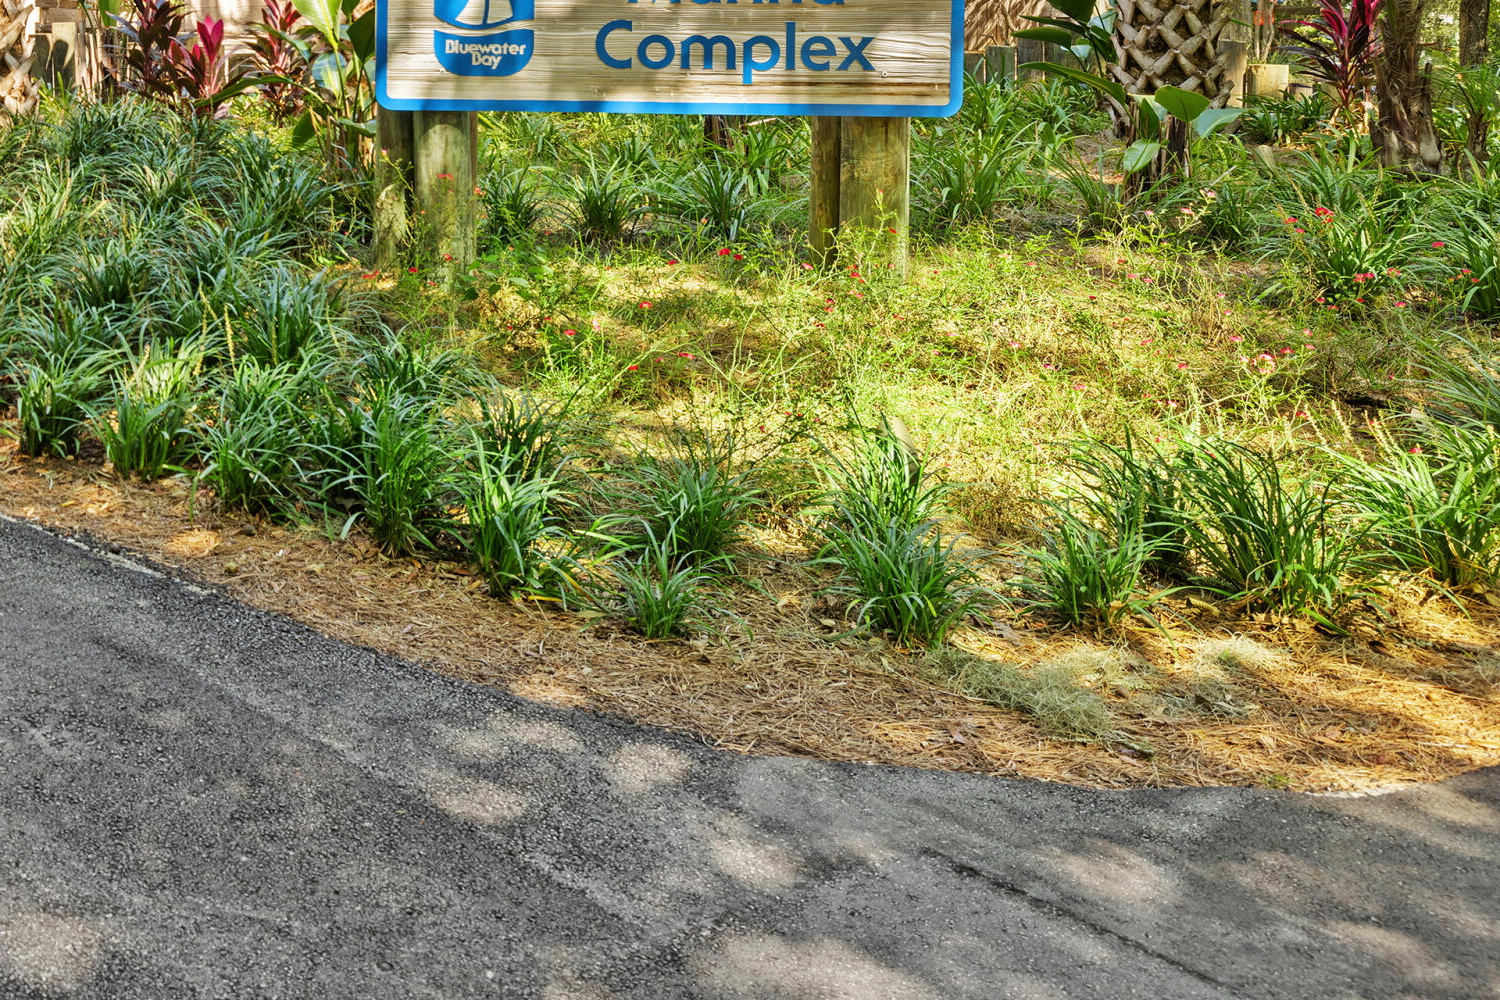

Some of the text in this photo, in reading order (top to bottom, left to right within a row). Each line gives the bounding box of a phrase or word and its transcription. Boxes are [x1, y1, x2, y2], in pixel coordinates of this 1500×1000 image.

[444, 39, 527, 56] Bluewater
[595, 19, 876, 86] Complex
[471, 51, 503, 70] Bay
